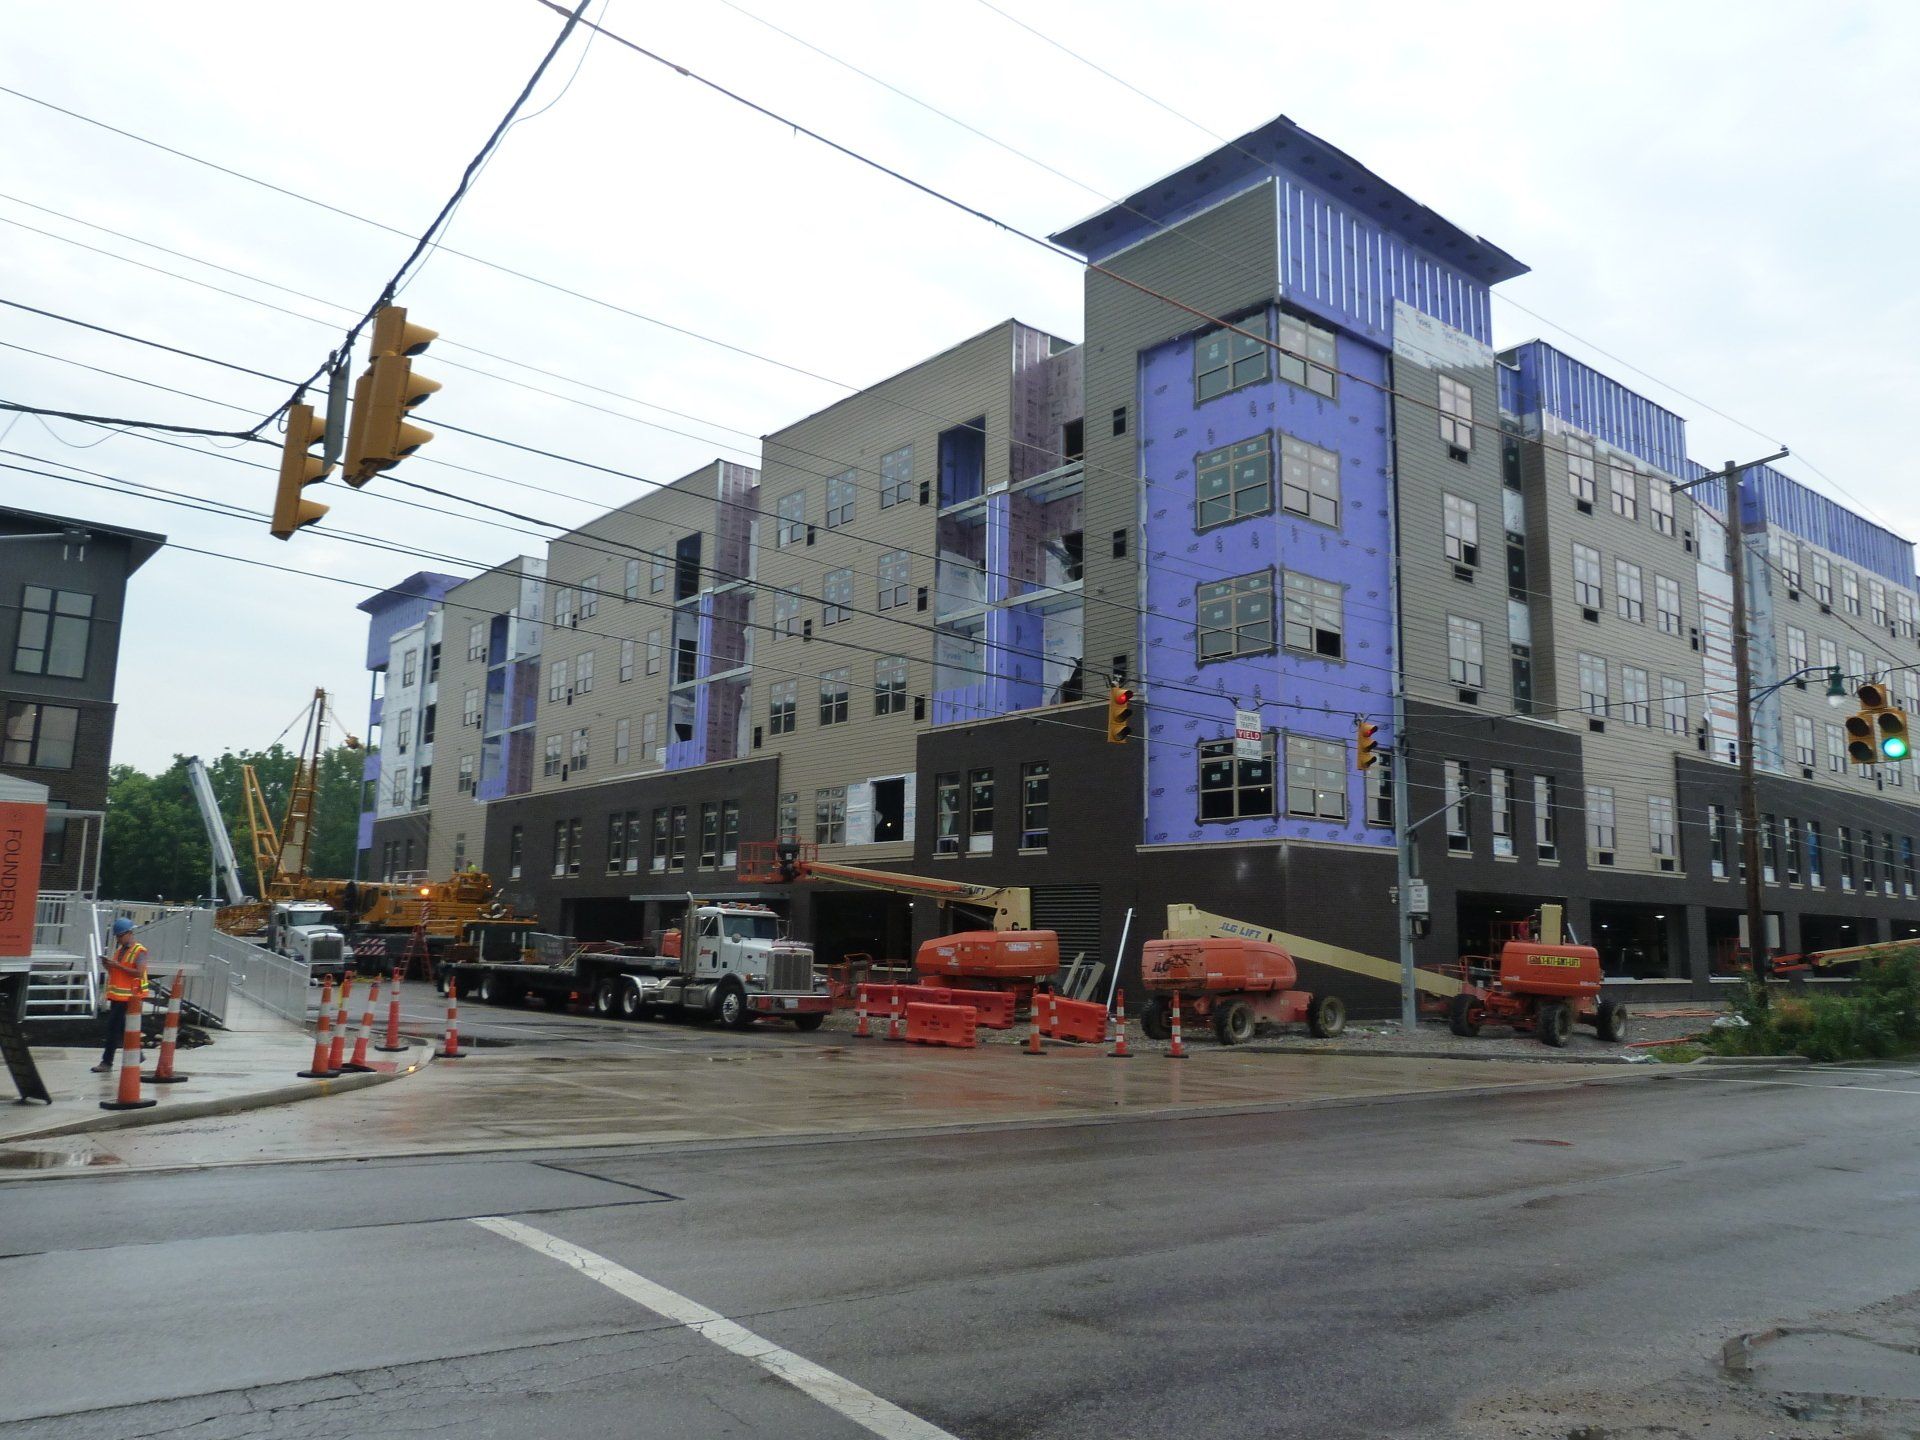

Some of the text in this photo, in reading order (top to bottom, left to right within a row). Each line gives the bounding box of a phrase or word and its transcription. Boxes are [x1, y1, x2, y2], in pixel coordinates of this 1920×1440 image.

[1239, 730, 1260, 740] YIELD
[0, 830, 22, 922] FOUNDERS
[1220, 921, 1262, 939] JLG LIFT
